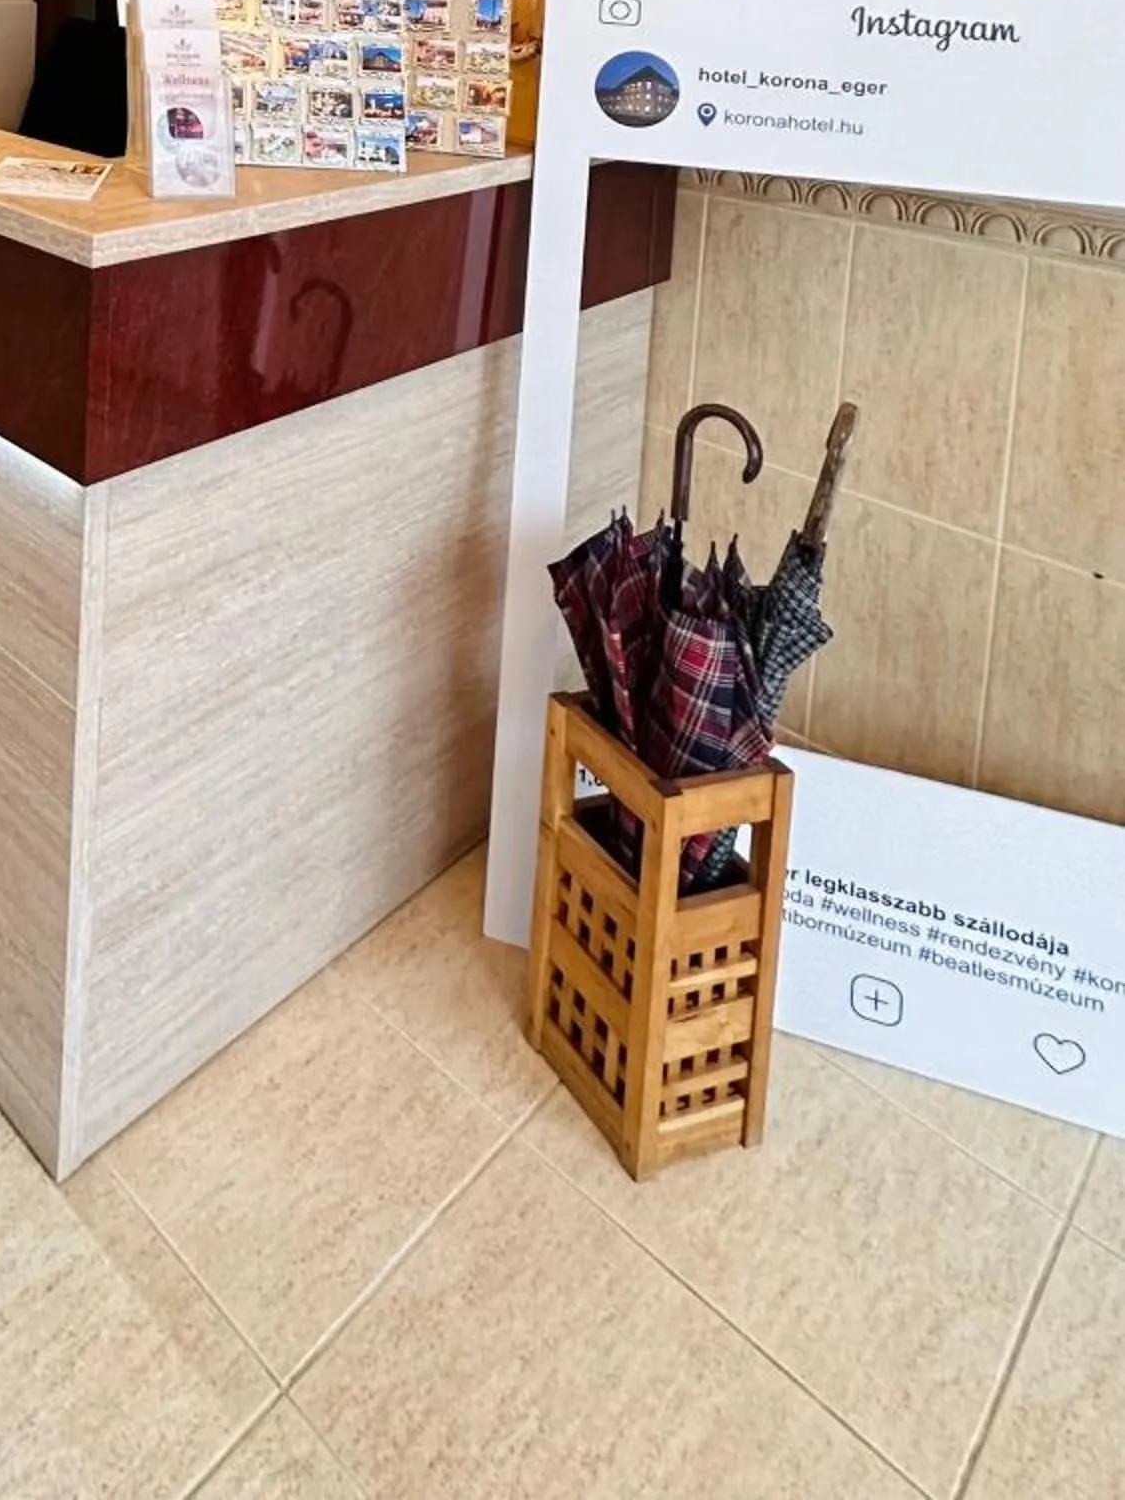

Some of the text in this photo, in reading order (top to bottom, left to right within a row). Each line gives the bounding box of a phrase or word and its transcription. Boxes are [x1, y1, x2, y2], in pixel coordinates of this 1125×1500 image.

[850, 5, 1021, 52] Instagram
[698, 67, 889, 97] hotel_korona_eger
[724, 109, 864, 136] koronahotel.hu
[805, 868, 947, 922] legklasszabb
[953, 912, 1070, 957] szállodája
[821, 896, 921, 938] #wellness
[927, 925, 1066, 981] #rendezvény
[918, 946, 1105, 1013] #beatlesmúzeum
